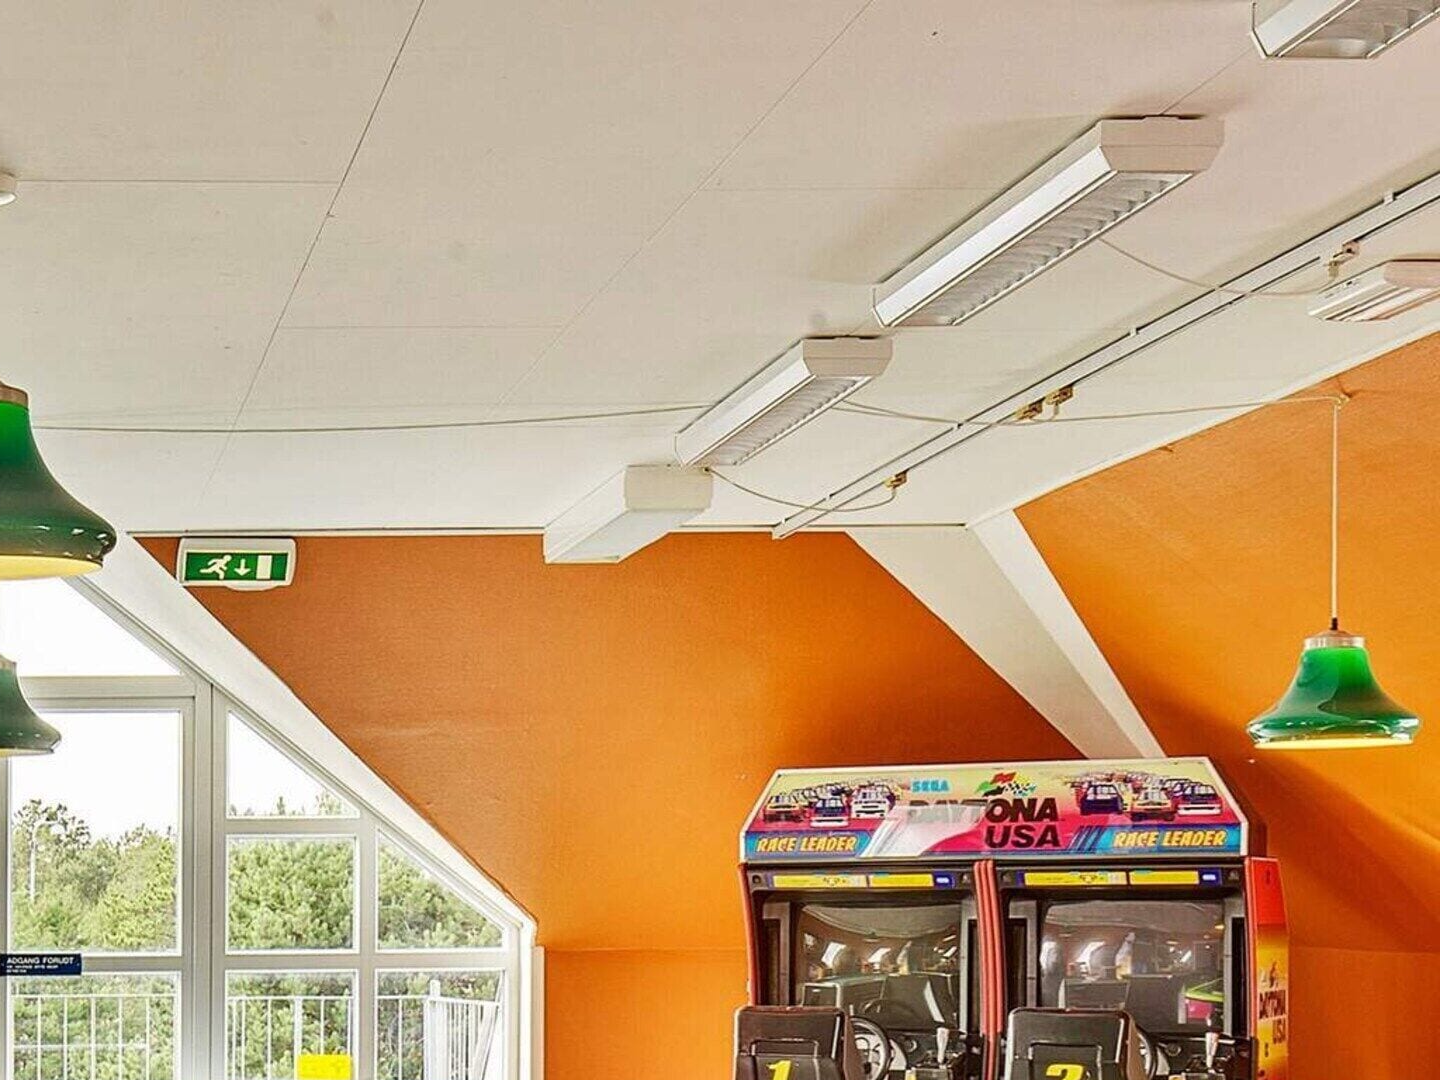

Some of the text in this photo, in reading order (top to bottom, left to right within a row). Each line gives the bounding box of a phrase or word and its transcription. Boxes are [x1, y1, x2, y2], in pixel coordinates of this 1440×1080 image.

[912, 780, 949, 792] SEGA
[757, 835, 859, 852] RACE LEADER
[986, 825, 1061, 848] USA
[1113, 830, 1227, 847] RACE LEADER
